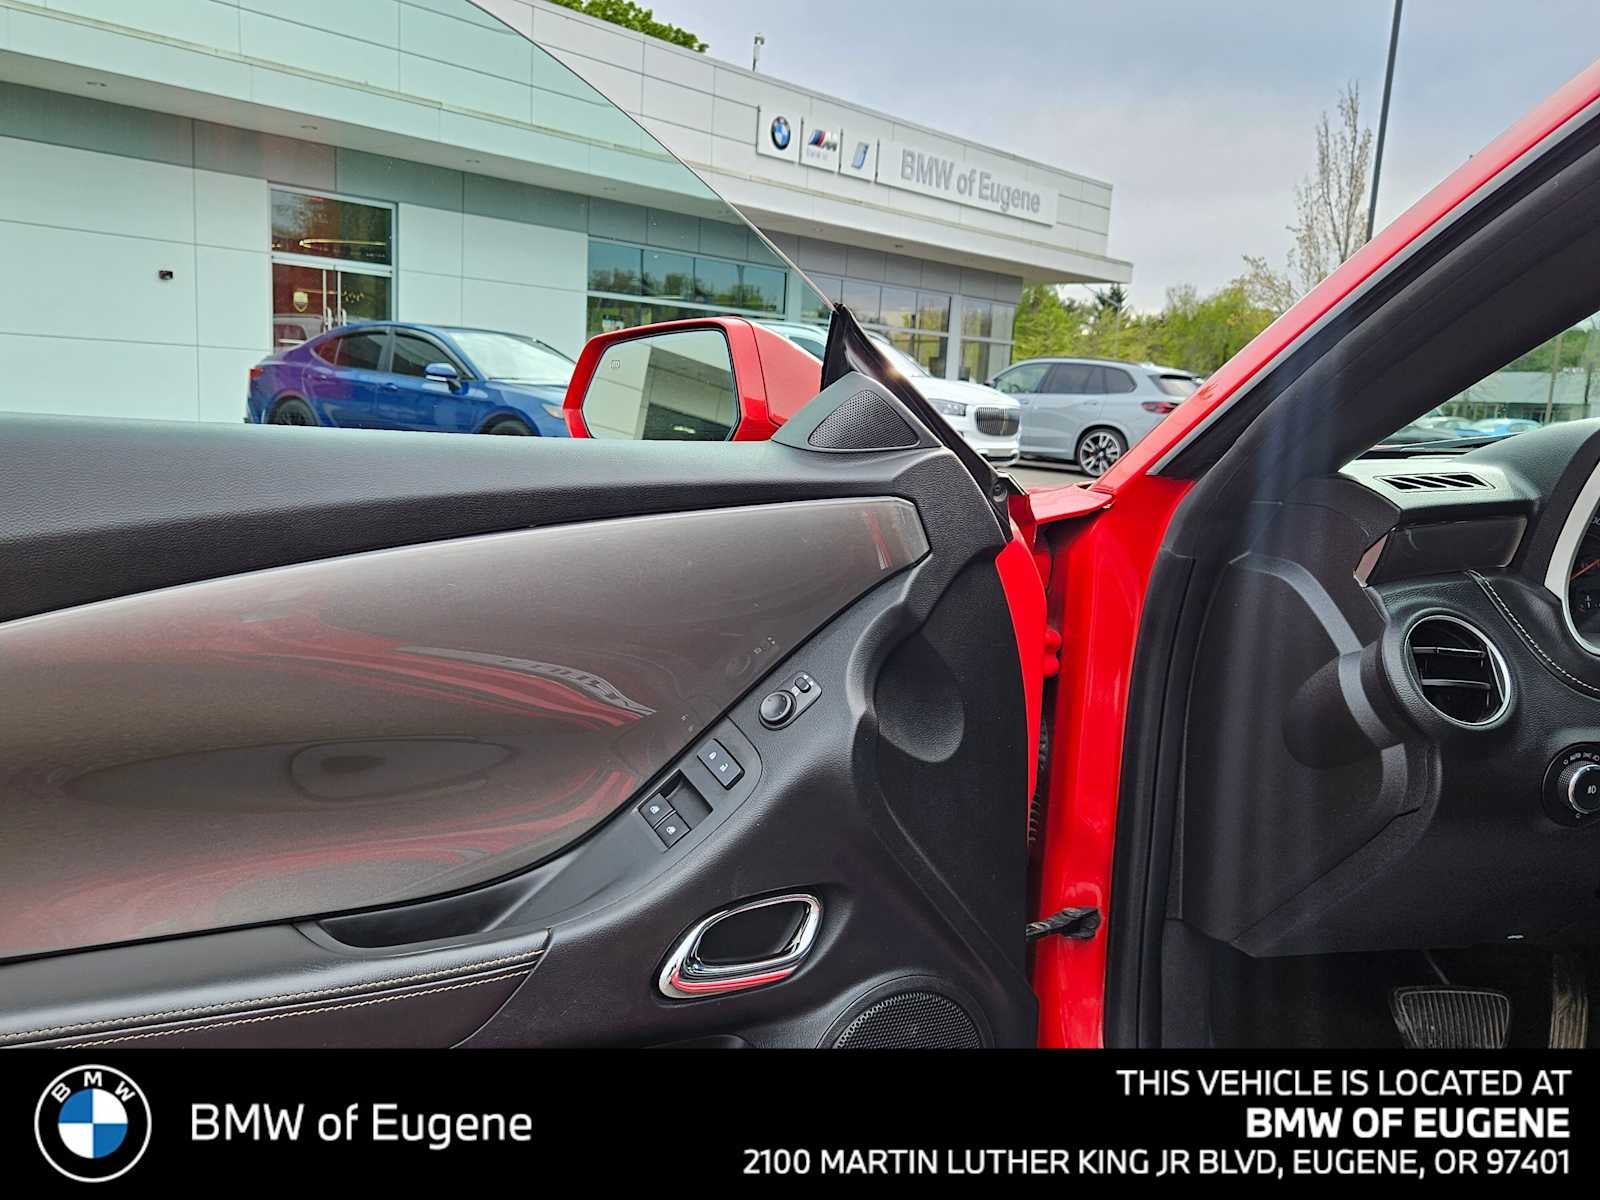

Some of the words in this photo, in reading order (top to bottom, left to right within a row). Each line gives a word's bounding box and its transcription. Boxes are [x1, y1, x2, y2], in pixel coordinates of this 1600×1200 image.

[900, 148, 955, 191] BMW
[956, 168, 977, 197] of
[978, 171, 1041, 213] Eugene
